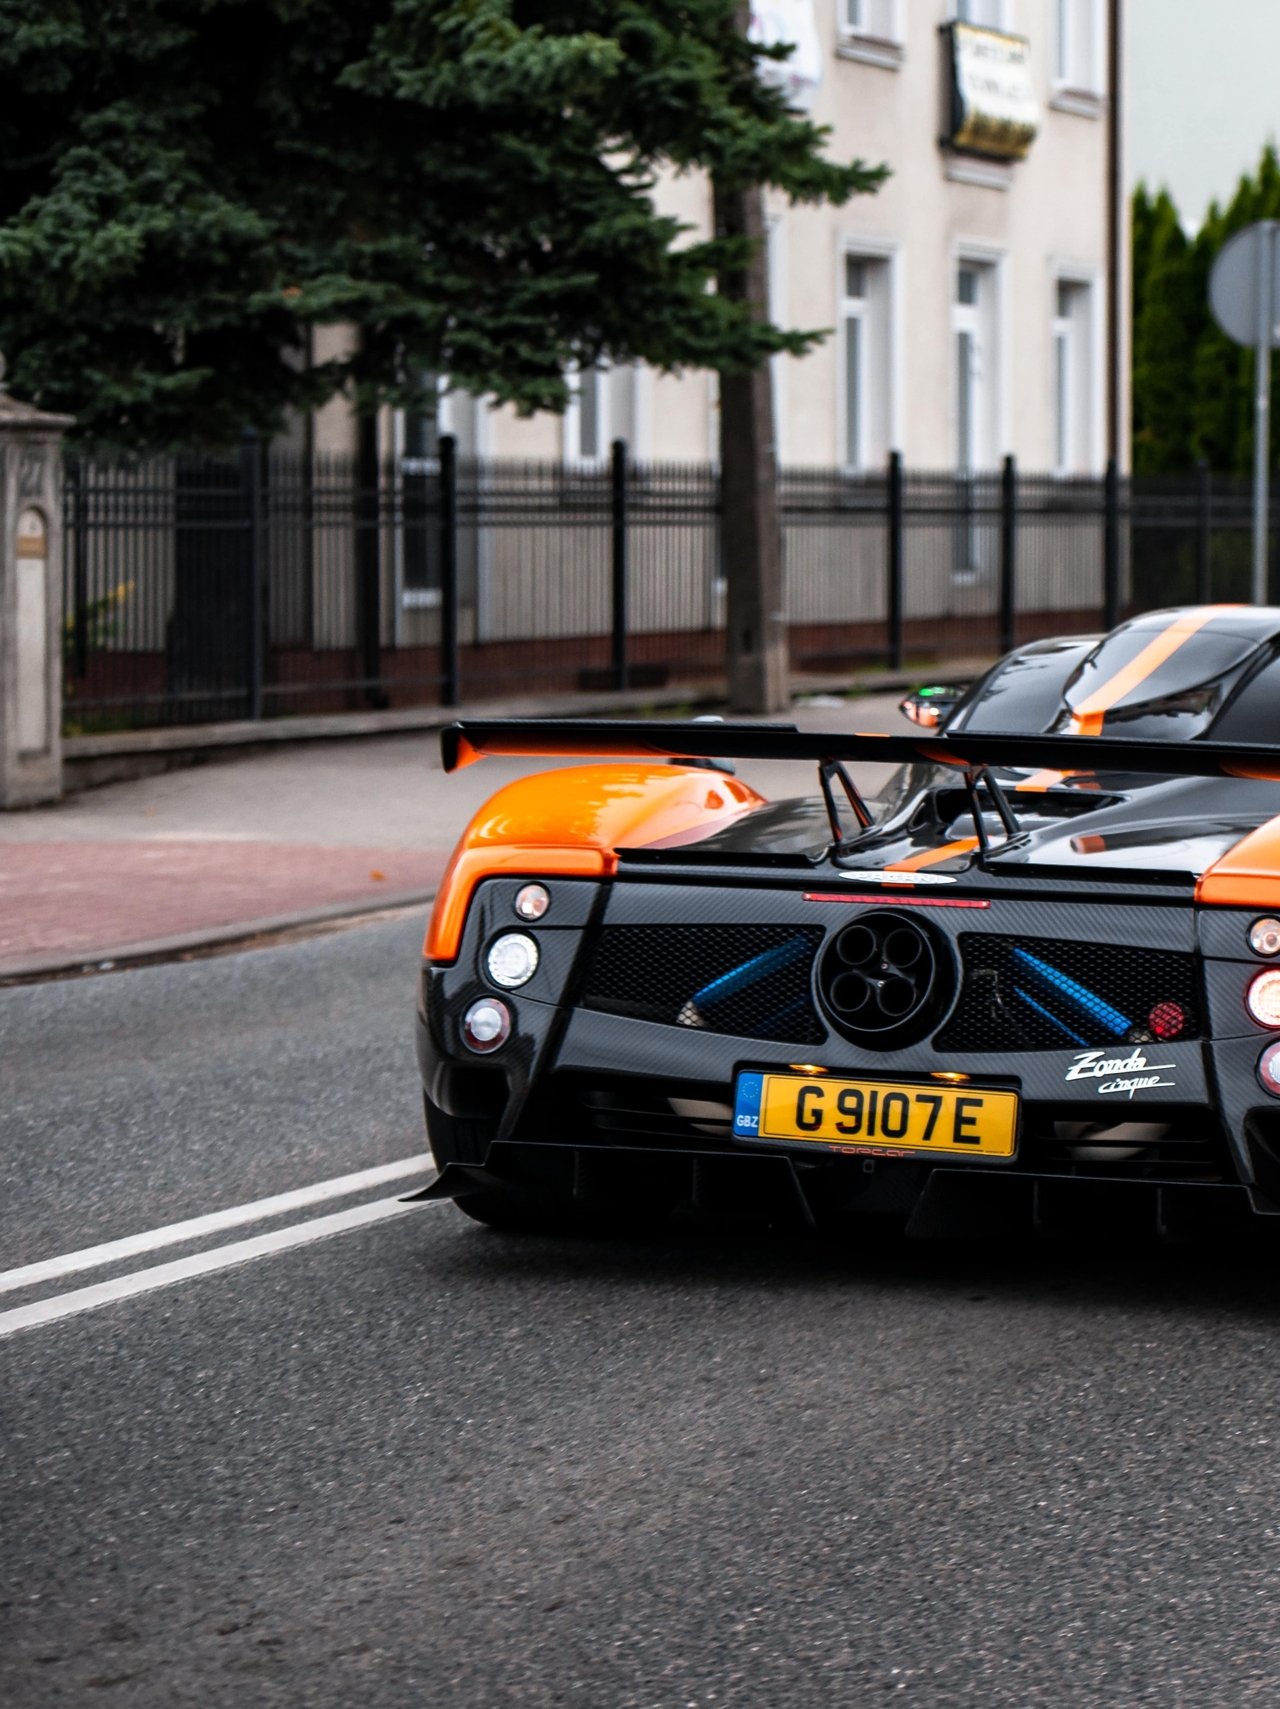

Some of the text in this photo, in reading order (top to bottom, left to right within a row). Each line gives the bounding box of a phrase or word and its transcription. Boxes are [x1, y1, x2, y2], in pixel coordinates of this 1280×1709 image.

[855, 872, 940, 884] PAGANI
[1065, 1047, 1177, 1081] Zonda
[1098, 1076, 1176, 1100] cinque
[736, 1113, 759, 1128] GBZ
